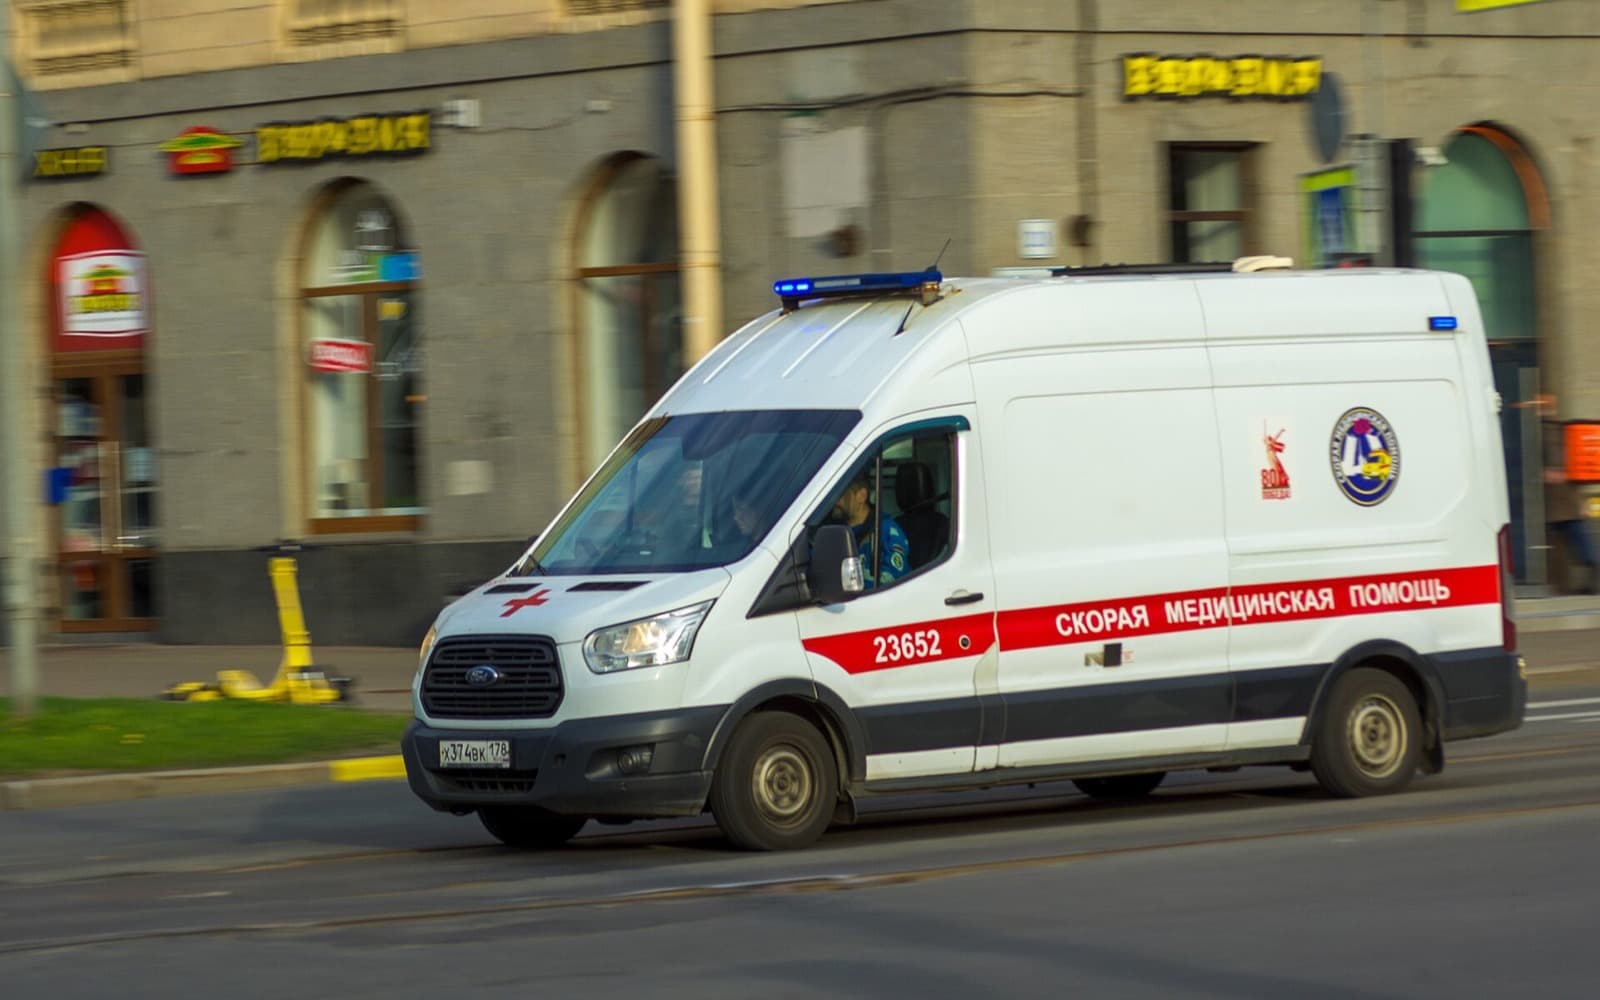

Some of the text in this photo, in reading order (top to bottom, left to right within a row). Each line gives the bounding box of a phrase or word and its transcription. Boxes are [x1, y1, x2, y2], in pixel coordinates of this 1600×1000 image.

[1261, 469, 1280, 488] 80
[1055, 578, 1451, 637] СКОРАЯ МЕДИЦИНСКАЯ ПОМОЩЬ
[873, 629, 942, 663] 23652
[489, 742, 507, 757] 178
